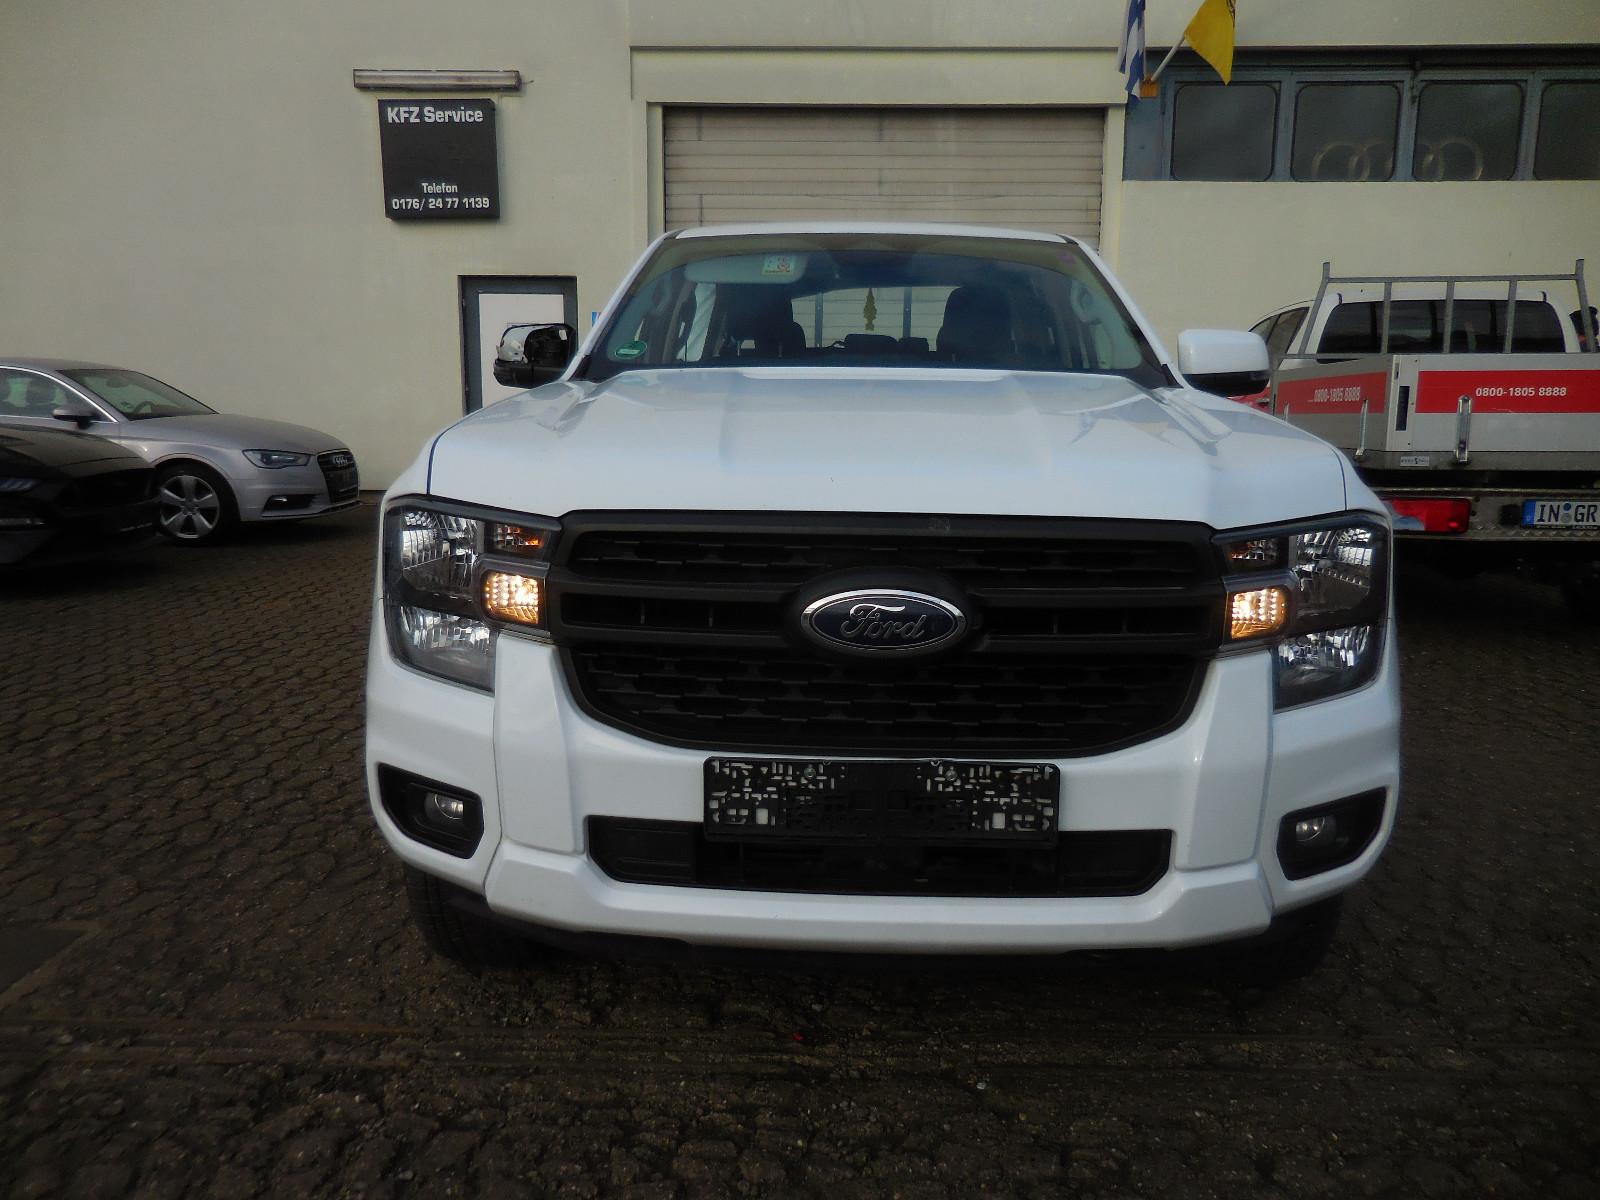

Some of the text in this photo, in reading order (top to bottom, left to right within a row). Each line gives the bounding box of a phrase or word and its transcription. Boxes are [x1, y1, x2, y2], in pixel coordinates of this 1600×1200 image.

[387, 106, 484, 123] KFZ Service
[421, 182, 458, 193] Telefon
[392, 197, 490, 211] 0176/ 24 77 1139
[1475, 386, 1567, 397] 0800-1805 8888
[1536, 504, 1598, 523] IN GR
[840, 603, 927, 639] Ford
